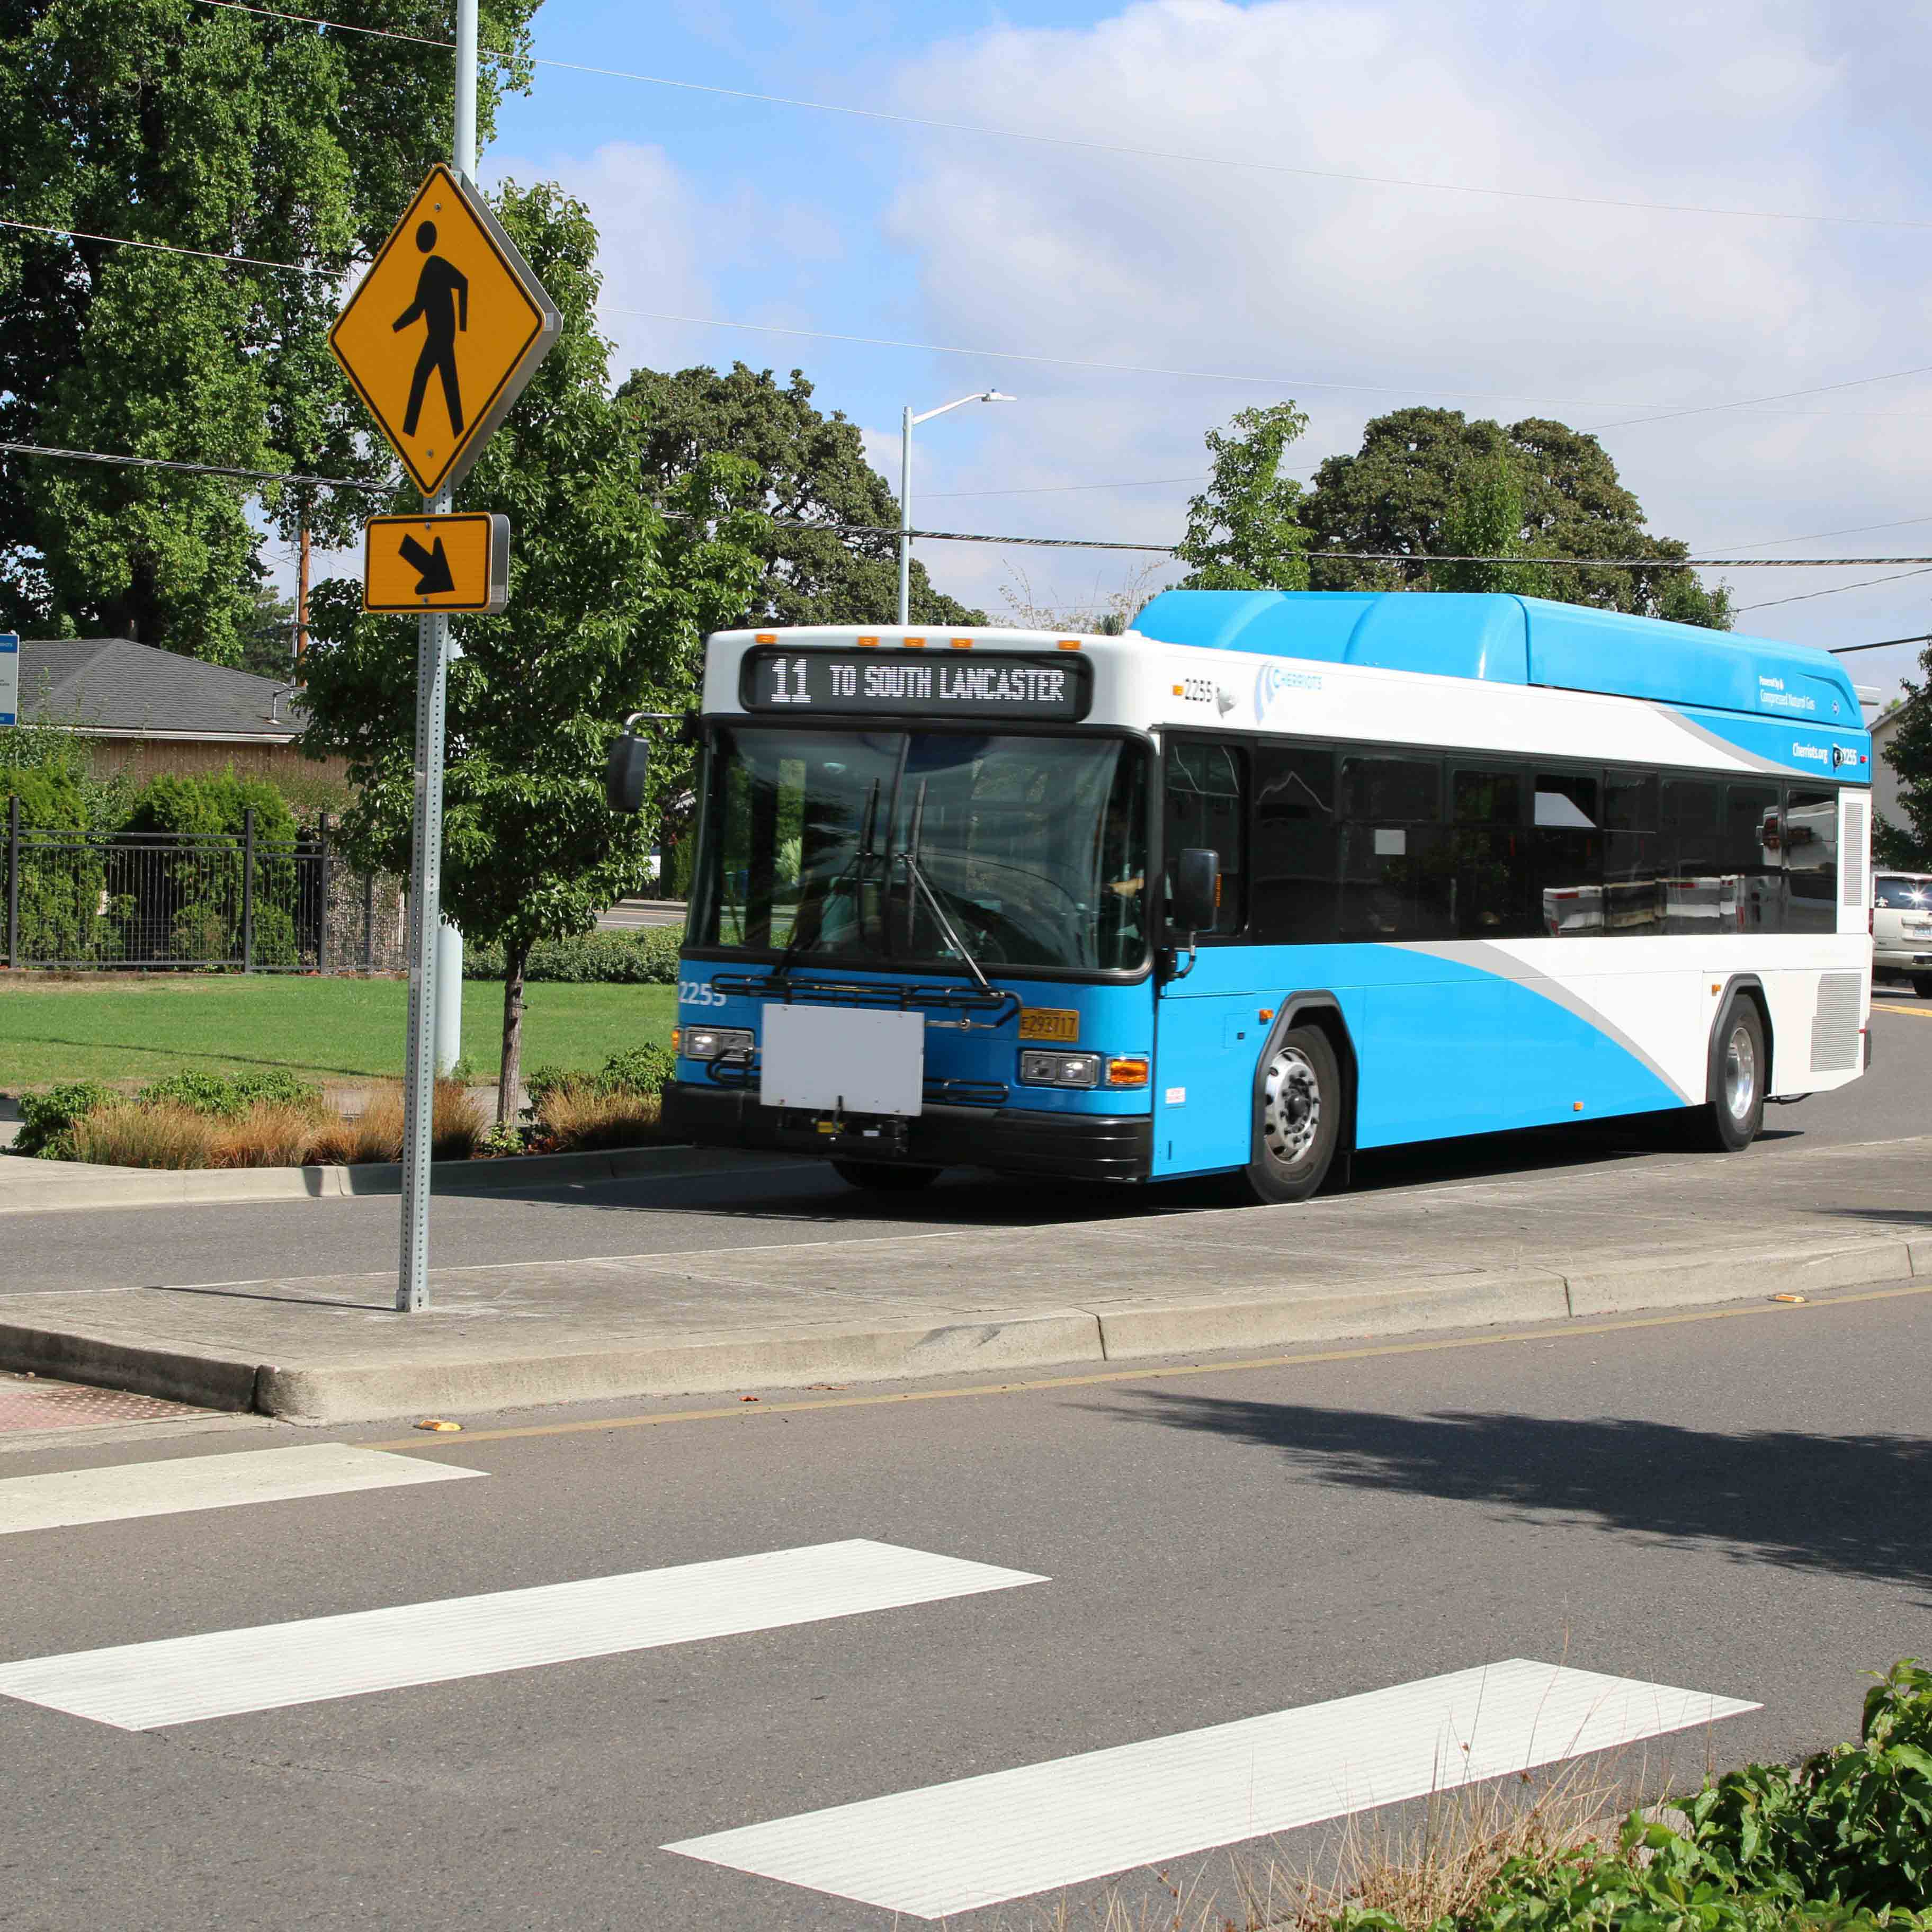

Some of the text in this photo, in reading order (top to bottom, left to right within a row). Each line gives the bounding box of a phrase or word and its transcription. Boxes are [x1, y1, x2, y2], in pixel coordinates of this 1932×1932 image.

[771, 658, 1065, 703] 11 TO SOUTH LANCASTER
[1185, 678, 1213, 703] 2255
[1793, 742, 1828, 765] Cherriots.org
[678, 981, 727, 1006] 2255
